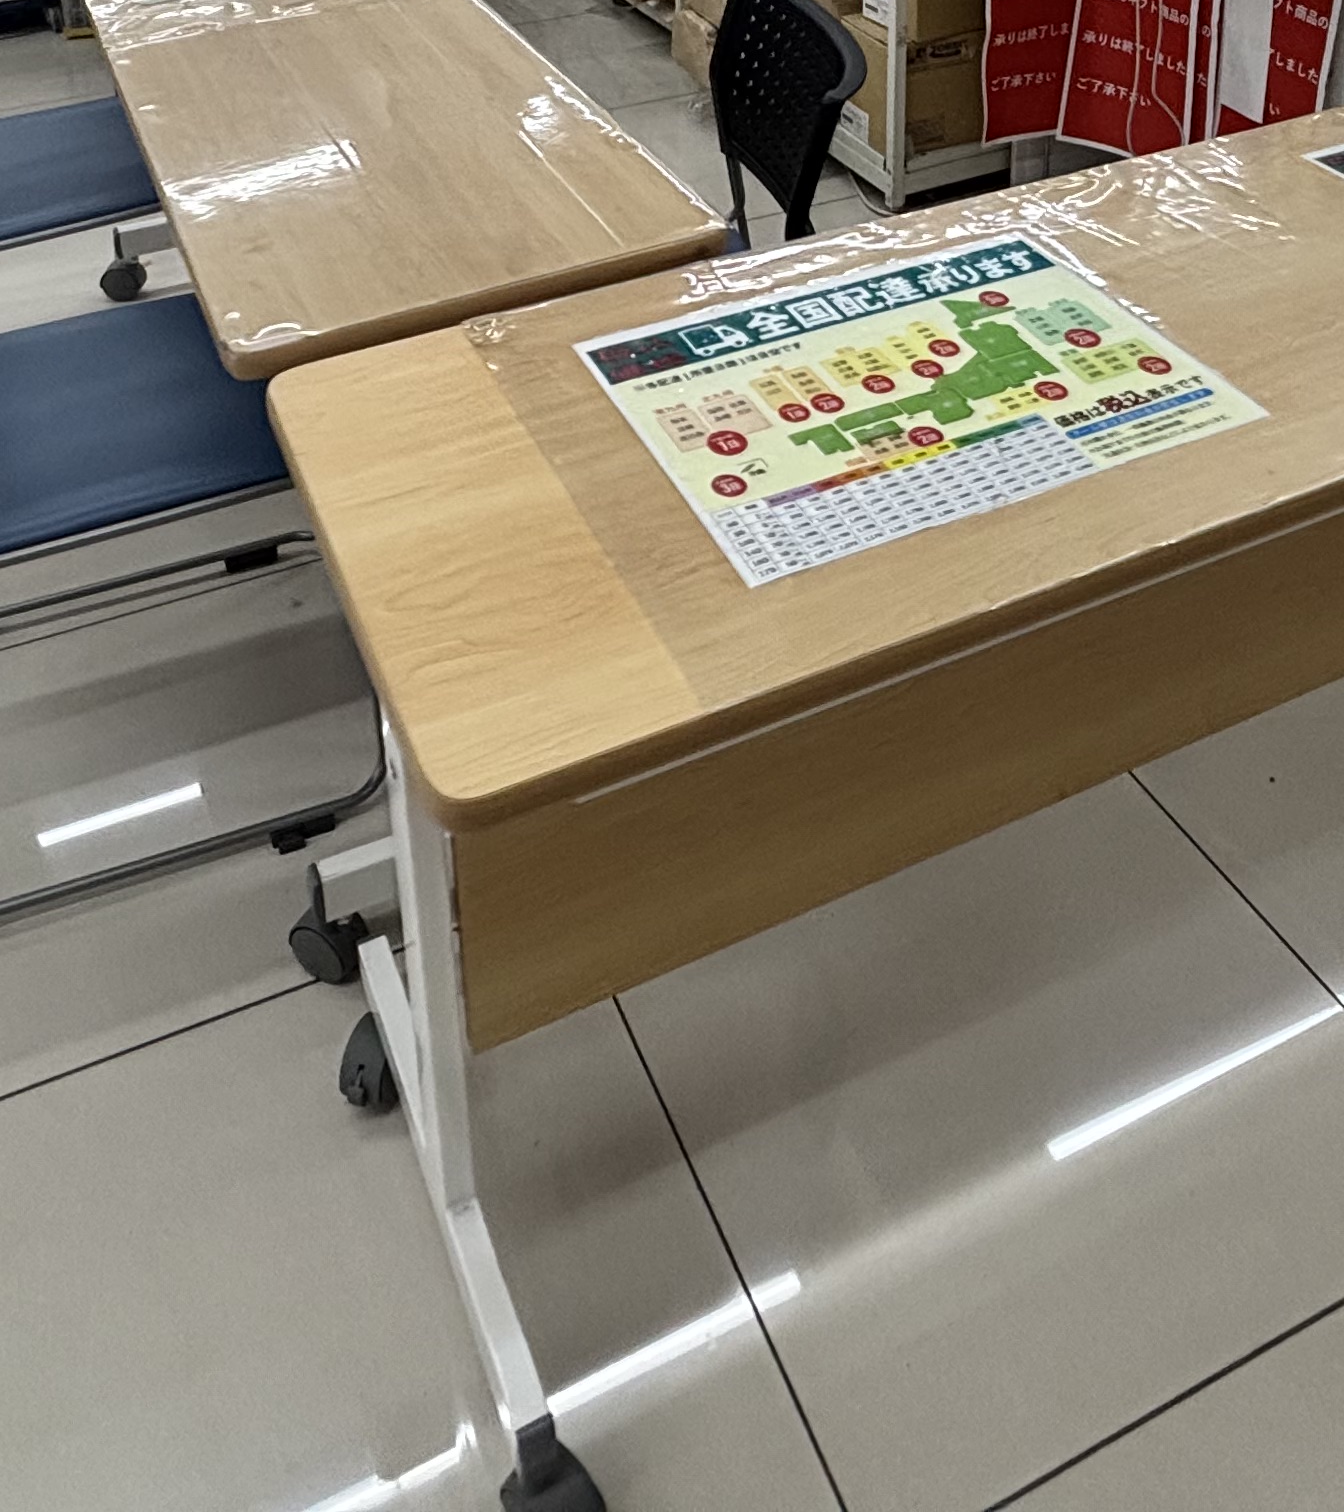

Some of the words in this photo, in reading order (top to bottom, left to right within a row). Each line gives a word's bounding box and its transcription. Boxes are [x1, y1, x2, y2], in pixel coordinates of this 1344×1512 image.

[990, 71, 1057, 92] ご了承下さい
[1076, 76, 1153, 108] ご了承下さい
[746, 247, 1036, 343] 全国配達承ります
[1054, 374, 1206, 428] 価格は税込表示です
